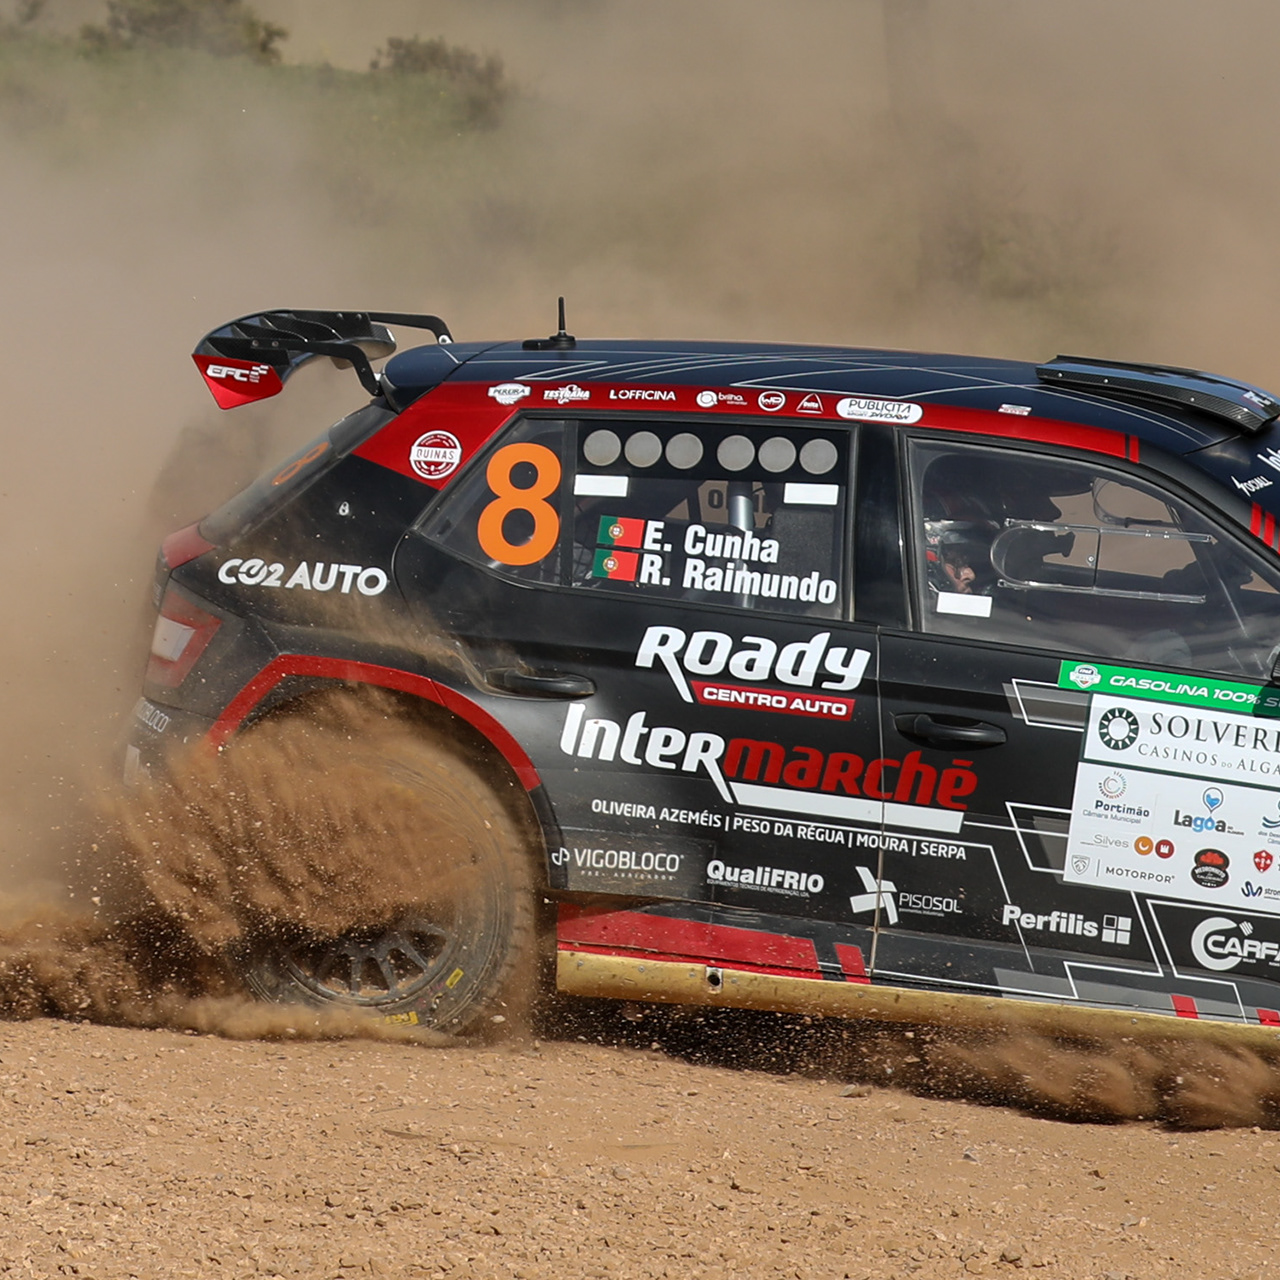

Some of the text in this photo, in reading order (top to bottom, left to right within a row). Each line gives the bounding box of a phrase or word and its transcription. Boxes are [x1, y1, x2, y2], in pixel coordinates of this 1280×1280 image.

[415, 447, 455, 461] QUINAS
[477, 442, 562, 566] 8
[644, 519, 780, 564] E. Cunha
[284, 560, 389, 596] AUTO
[639, 552, 838, 605] R. Raimundo
[635, 625, 872, 704] Roady
[702, 686, 849, 716] CENTRO AUTO
[1109, 675, 1209, 698] GASOLINA
[1212, 688, 1262, 705] 100%
[1138, 743, 1218, 766] CASINOS
[1094, 799, 1150, 818] Portimão
[1173, 809, 1226, 833] Lagoa
[591, 799, 967, 860] OLIVEIRA AZEMÉIS PESO DA RÉGUA MOURA SERPA
[1093, 833, 1130, 849] Silves
[574, 847, 681, 873] VIGOBLOCO
[1105, 866, 1173, 884] MOTORPOR
[706, 859, 825, 894] QualiFRIO
[898, 891, 963, 914] PISOSOL
[1001, 903, 1099, 938] Perfilis
